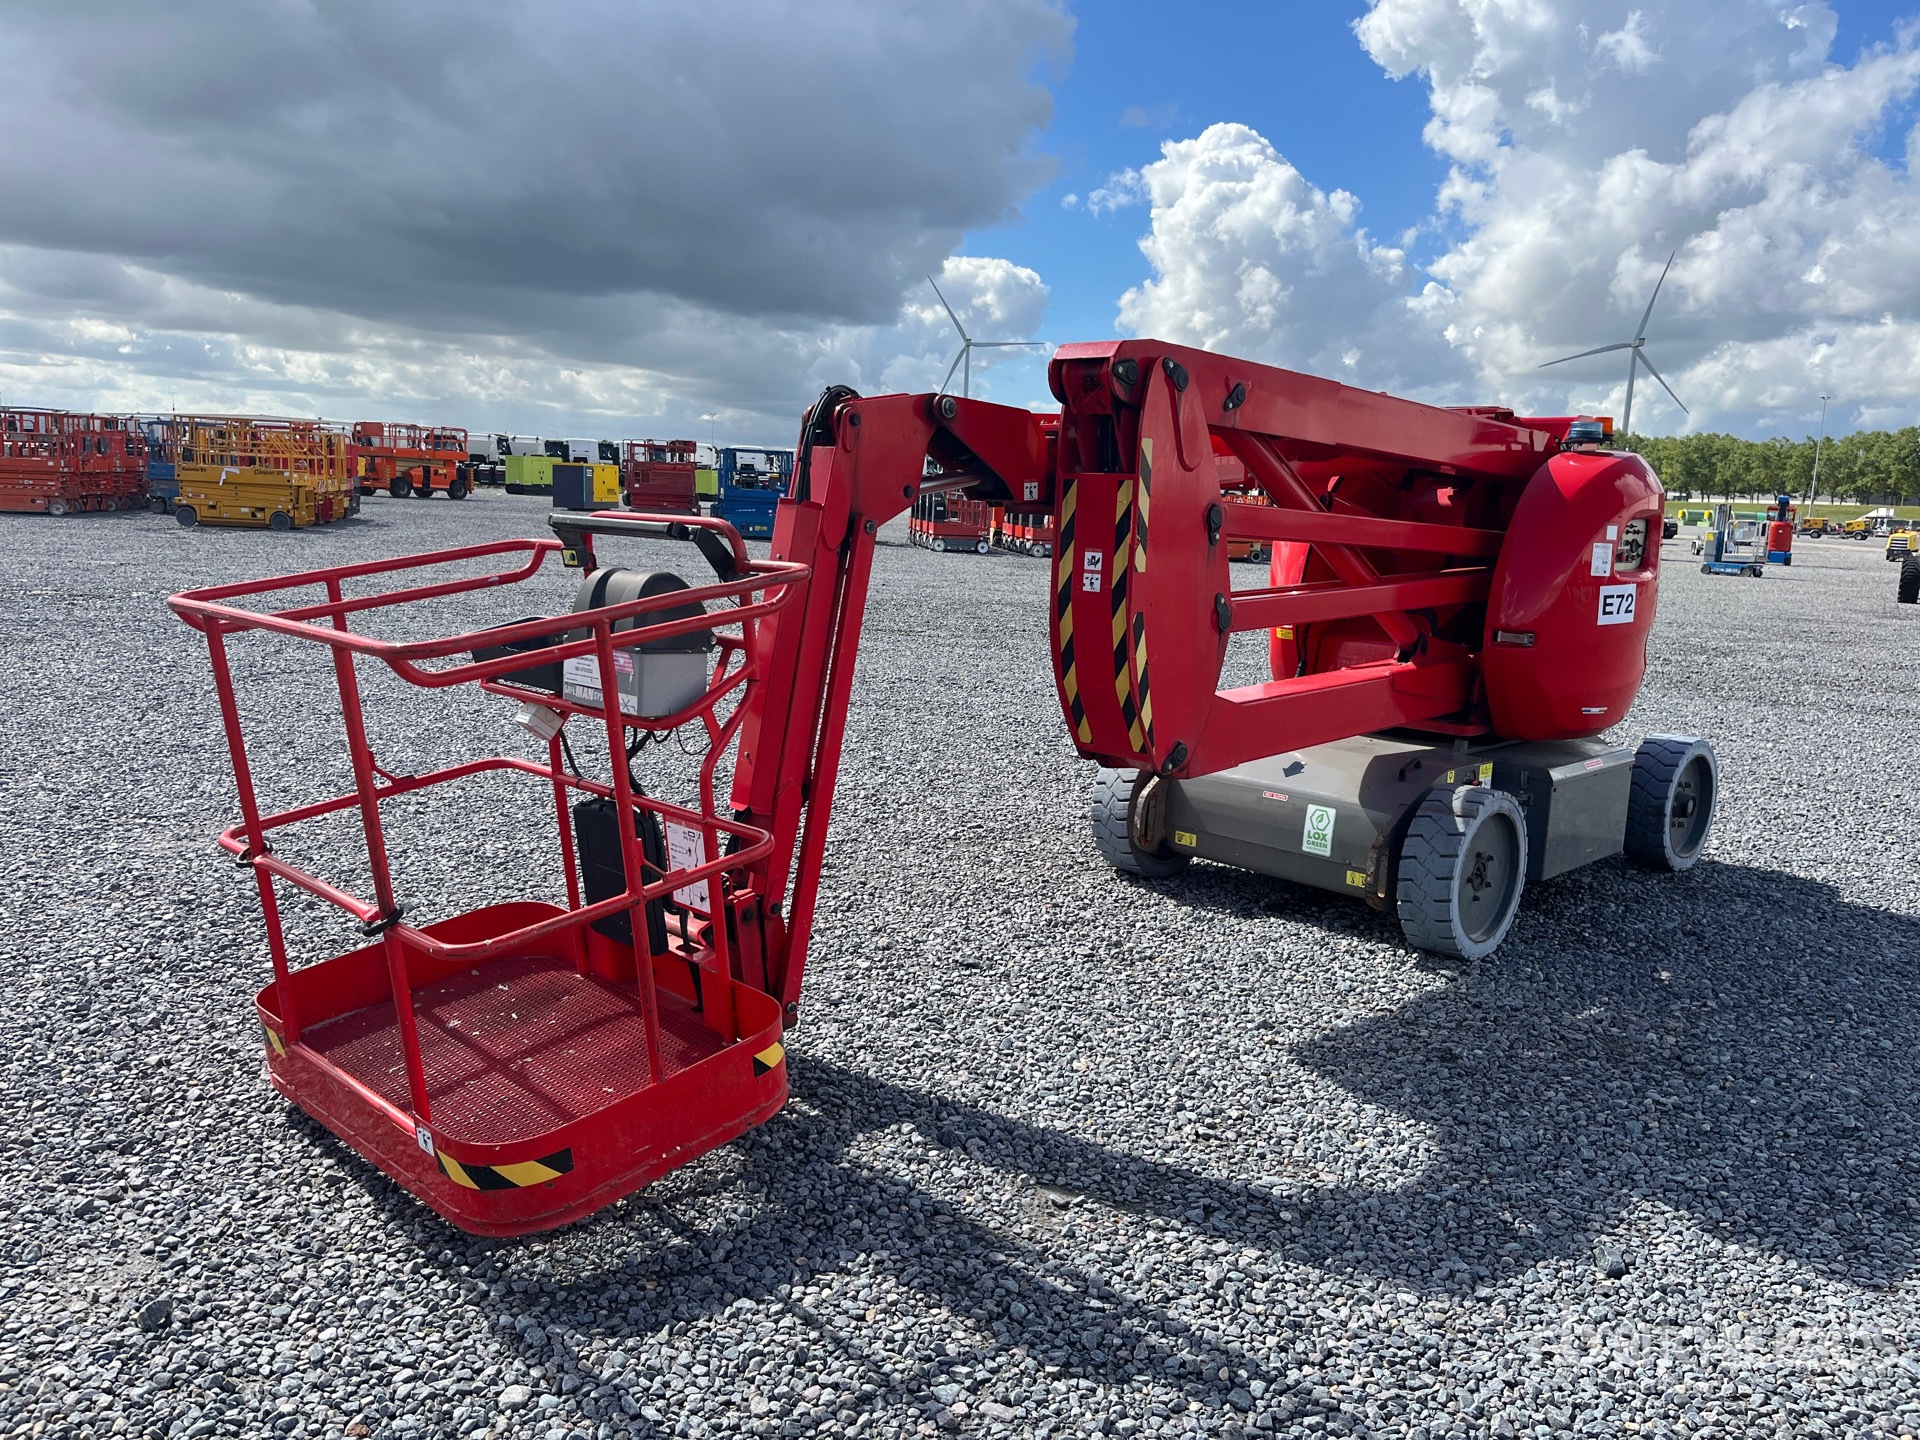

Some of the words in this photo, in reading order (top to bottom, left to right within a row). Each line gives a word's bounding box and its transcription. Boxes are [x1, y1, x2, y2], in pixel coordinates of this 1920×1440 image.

[1602, 593, 1634, 616] E72
[1307, 830, 1328, 842] LOX
[1306, 839, 1328, 849] GREEN
